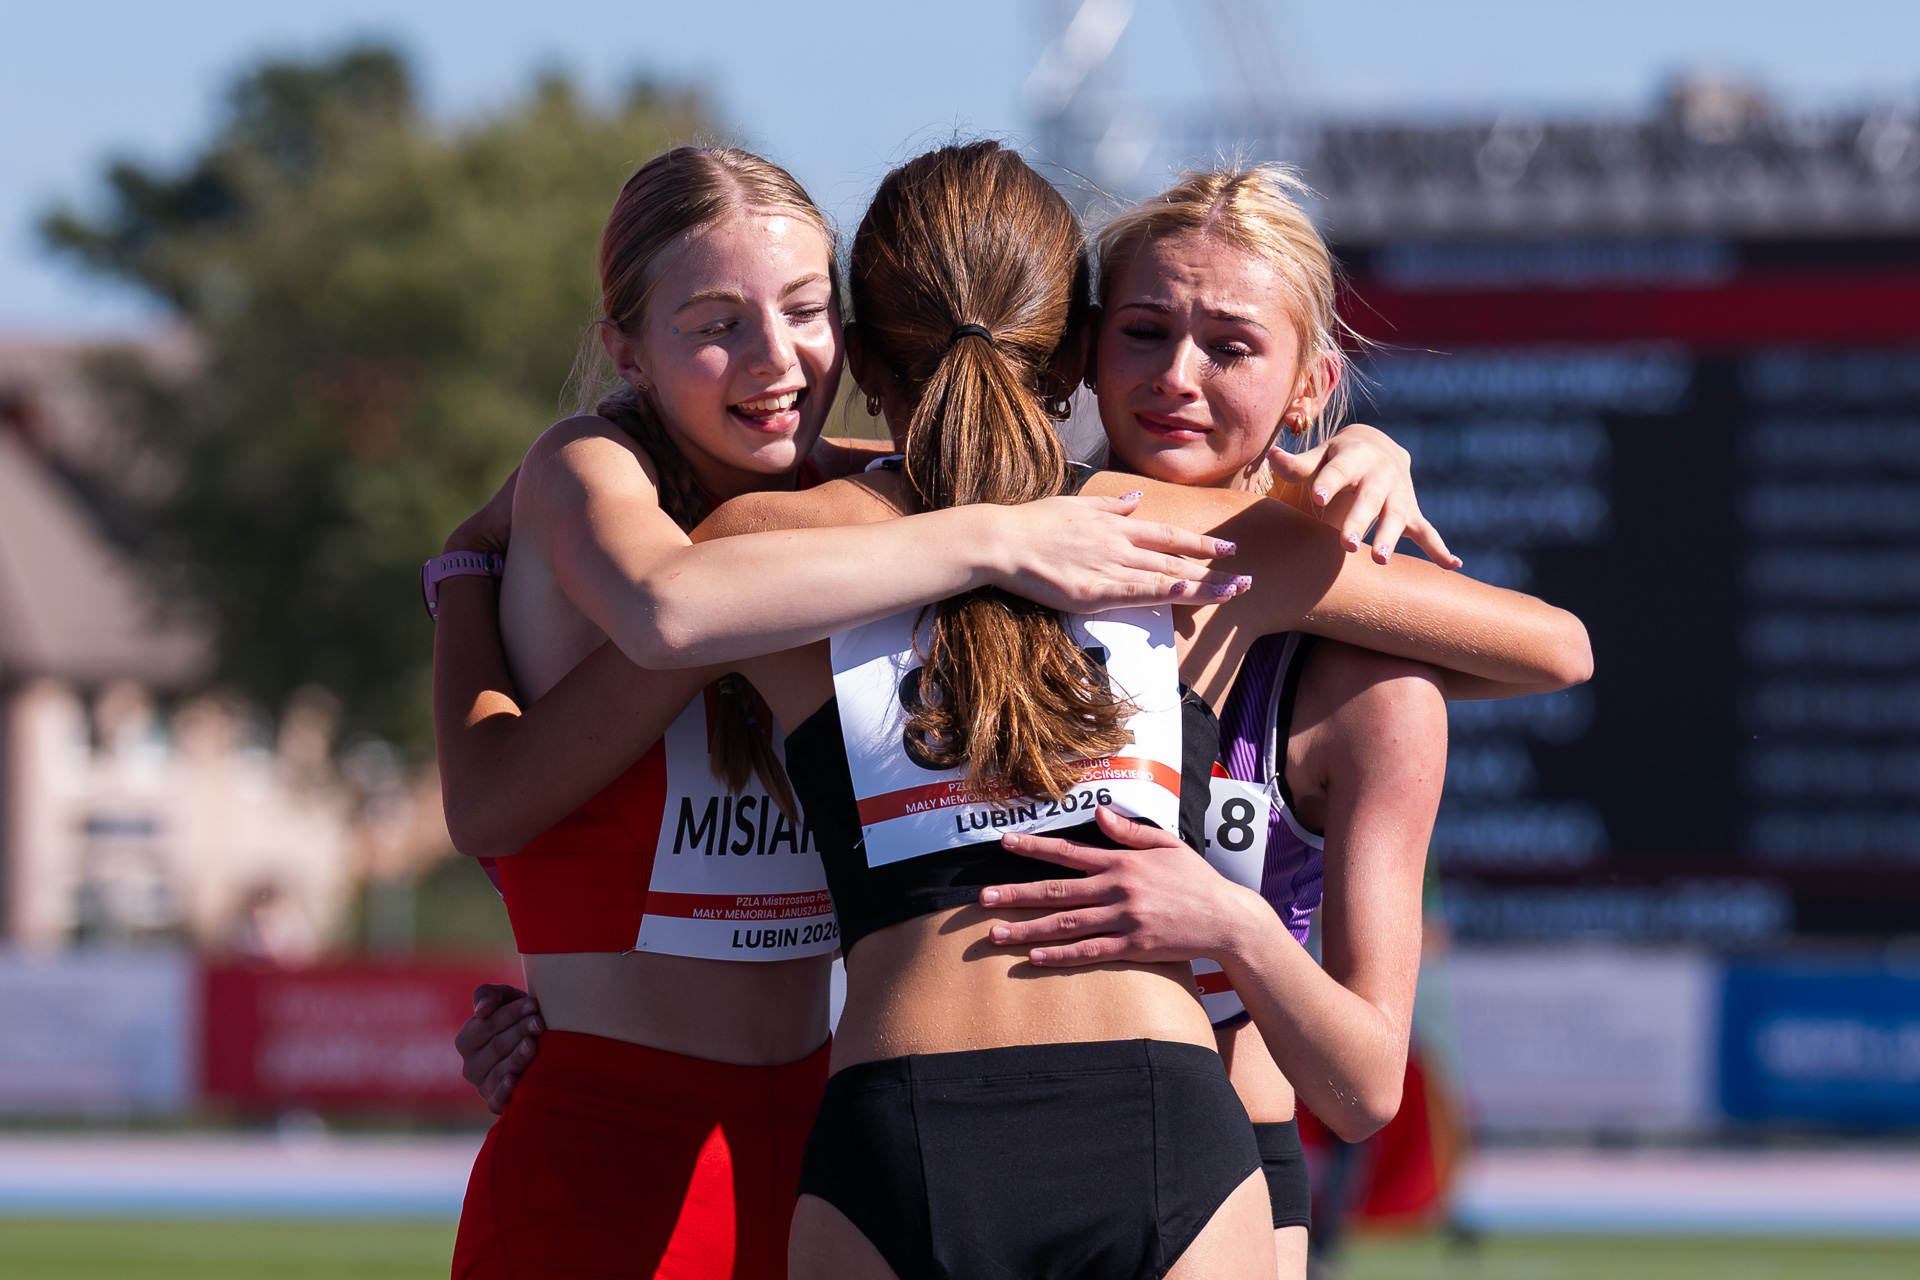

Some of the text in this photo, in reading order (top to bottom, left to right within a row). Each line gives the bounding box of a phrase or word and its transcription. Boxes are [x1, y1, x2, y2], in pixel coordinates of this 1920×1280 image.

[905, 798, 937, 813] MAŁY
[955, 788, 1113, 833] LUBIN 2026
[736, 897, 760, 906] PZLA
[762, 895, 815, 906] Mistrzostwa
[693, 908, 723, 918] MAŁY
[725, 909, 777, 919] MEMORIAŁ
[779, 906, 817, 918] JANUSZA
[732, 921, 839, 948] LUBIN 2026
